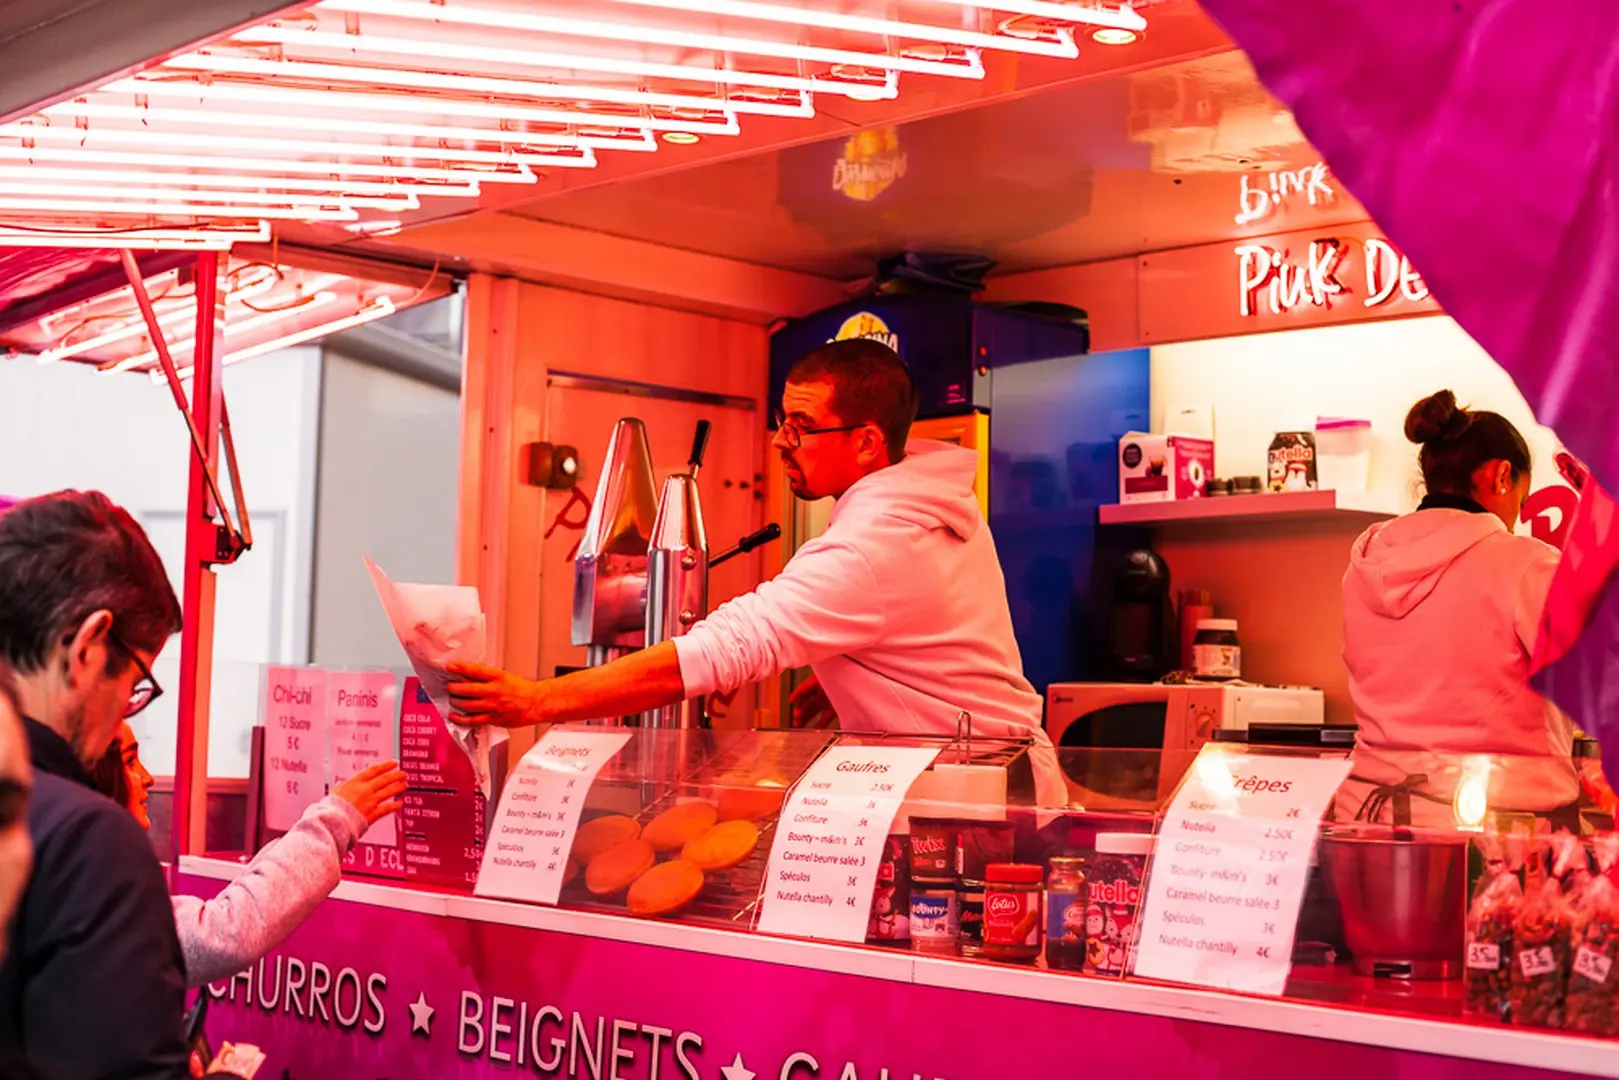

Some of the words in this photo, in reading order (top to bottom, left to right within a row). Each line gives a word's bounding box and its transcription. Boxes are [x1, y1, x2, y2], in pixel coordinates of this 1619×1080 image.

[273, 684, 312, 704] Chi-chi
[338, 689, 378, 708] Paninis
[836, 760, 891, 774] Gaufres
[1232, 775, 1293, 794] rêpes
[793, 813, 829, 825] Confiture
[1180, 820, 1216, 833] Nutella
[787, 831, 813, 844] Bounty
[782, 851, 813, 863] Caramel
[813, 853, 838, 866] beurre
[779, 870, 811, 883] Spéculos
[776, 890, 803, 904] Nutella
[803, 895, 834, 908] chantilly
[1088, 879, 1144, 905] utella
[1166, 887, 1207, 902] Caramel
[1208, 892, 1242, 906] beurre
[1162, 910, 1205, 925] Spéculos
[1159, 933, 1194, 948] Nutella
[1195, 940, 1238, 956] chantilly
[208, 954, 387, 1033] HURROS
[458, 990, 702, 1080] BEIGNETS
